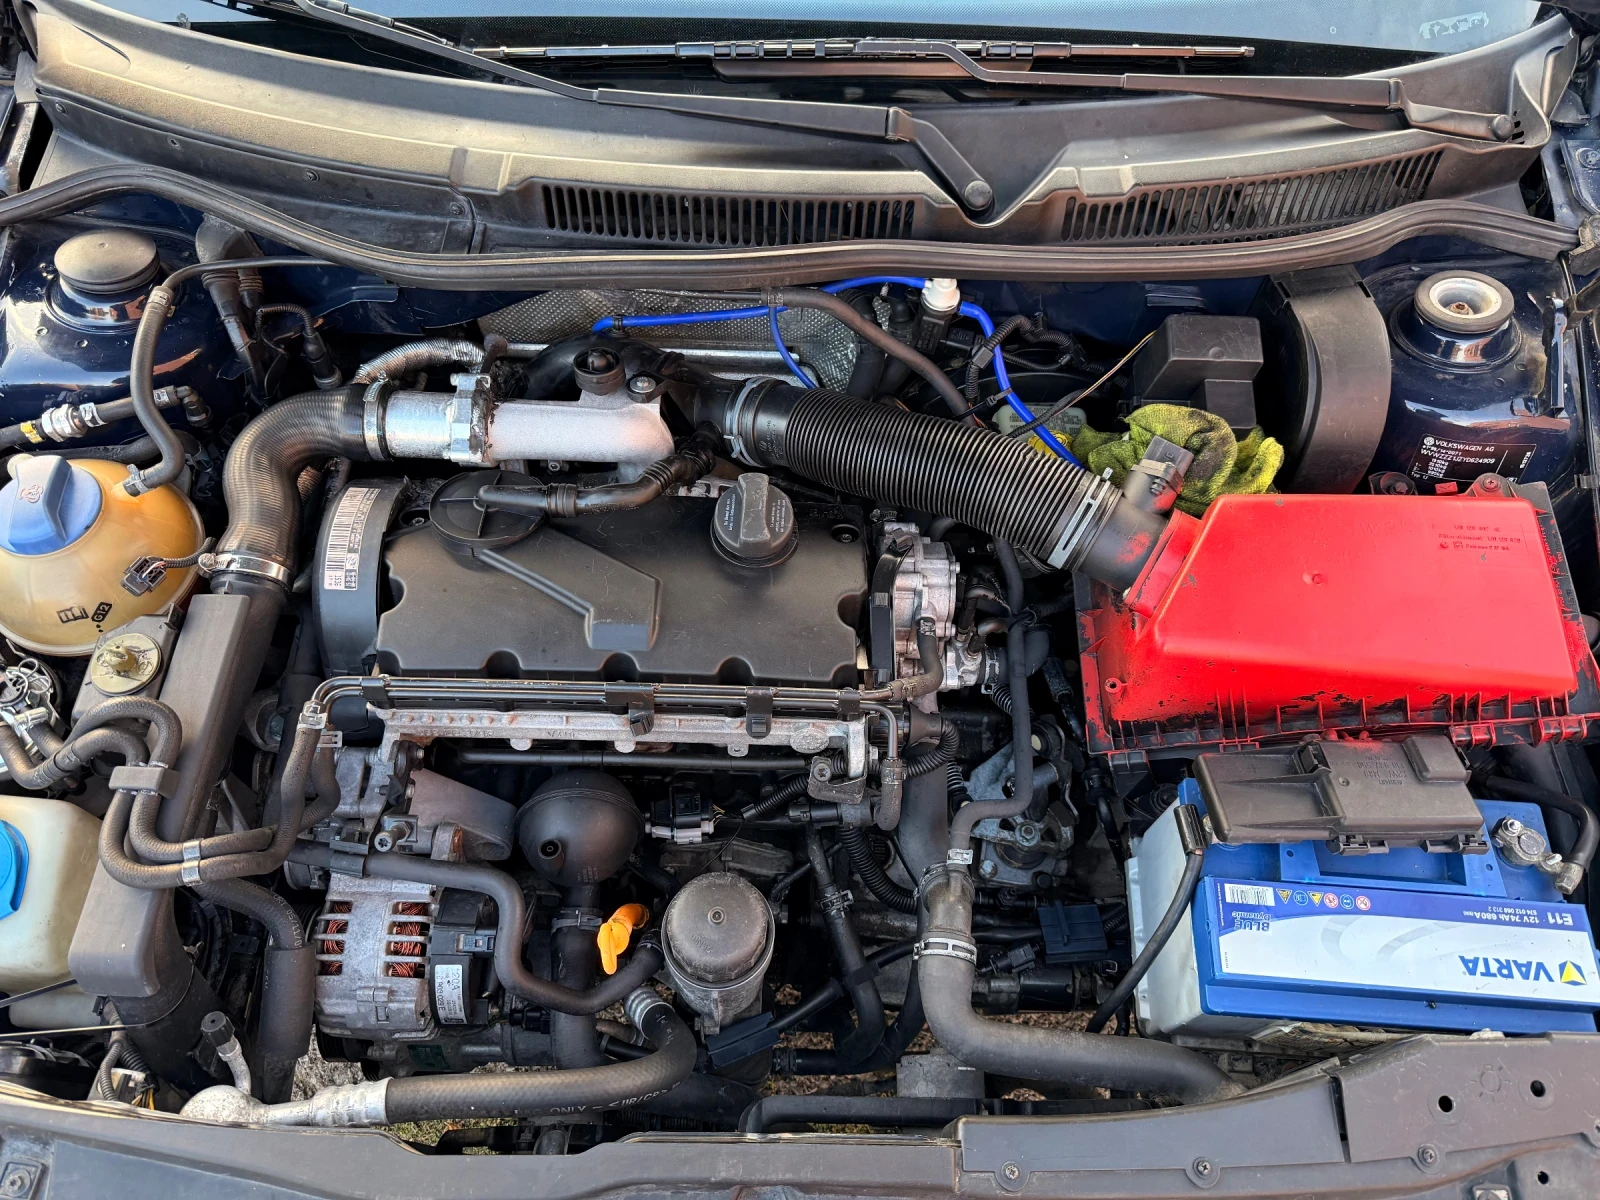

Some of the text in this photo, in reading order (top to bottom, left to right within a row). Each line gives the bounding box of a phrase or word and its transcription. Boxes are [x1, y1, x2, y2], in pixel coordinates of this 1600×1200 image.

[1435, 439, 1482, 451] VOLKSWAGEN
[93, 602, 110, 622] G12
[1231, 910, 1271, 921] Dynamic
[1498, 914, 1521, 922] 74Ah
[1523, 916, 1539, 924] 12V
[1546, 912, 1574, 926] E11
[1233, 919, 1270, 932] BLUE
[1457, 956, 1555, 983] VARTA
